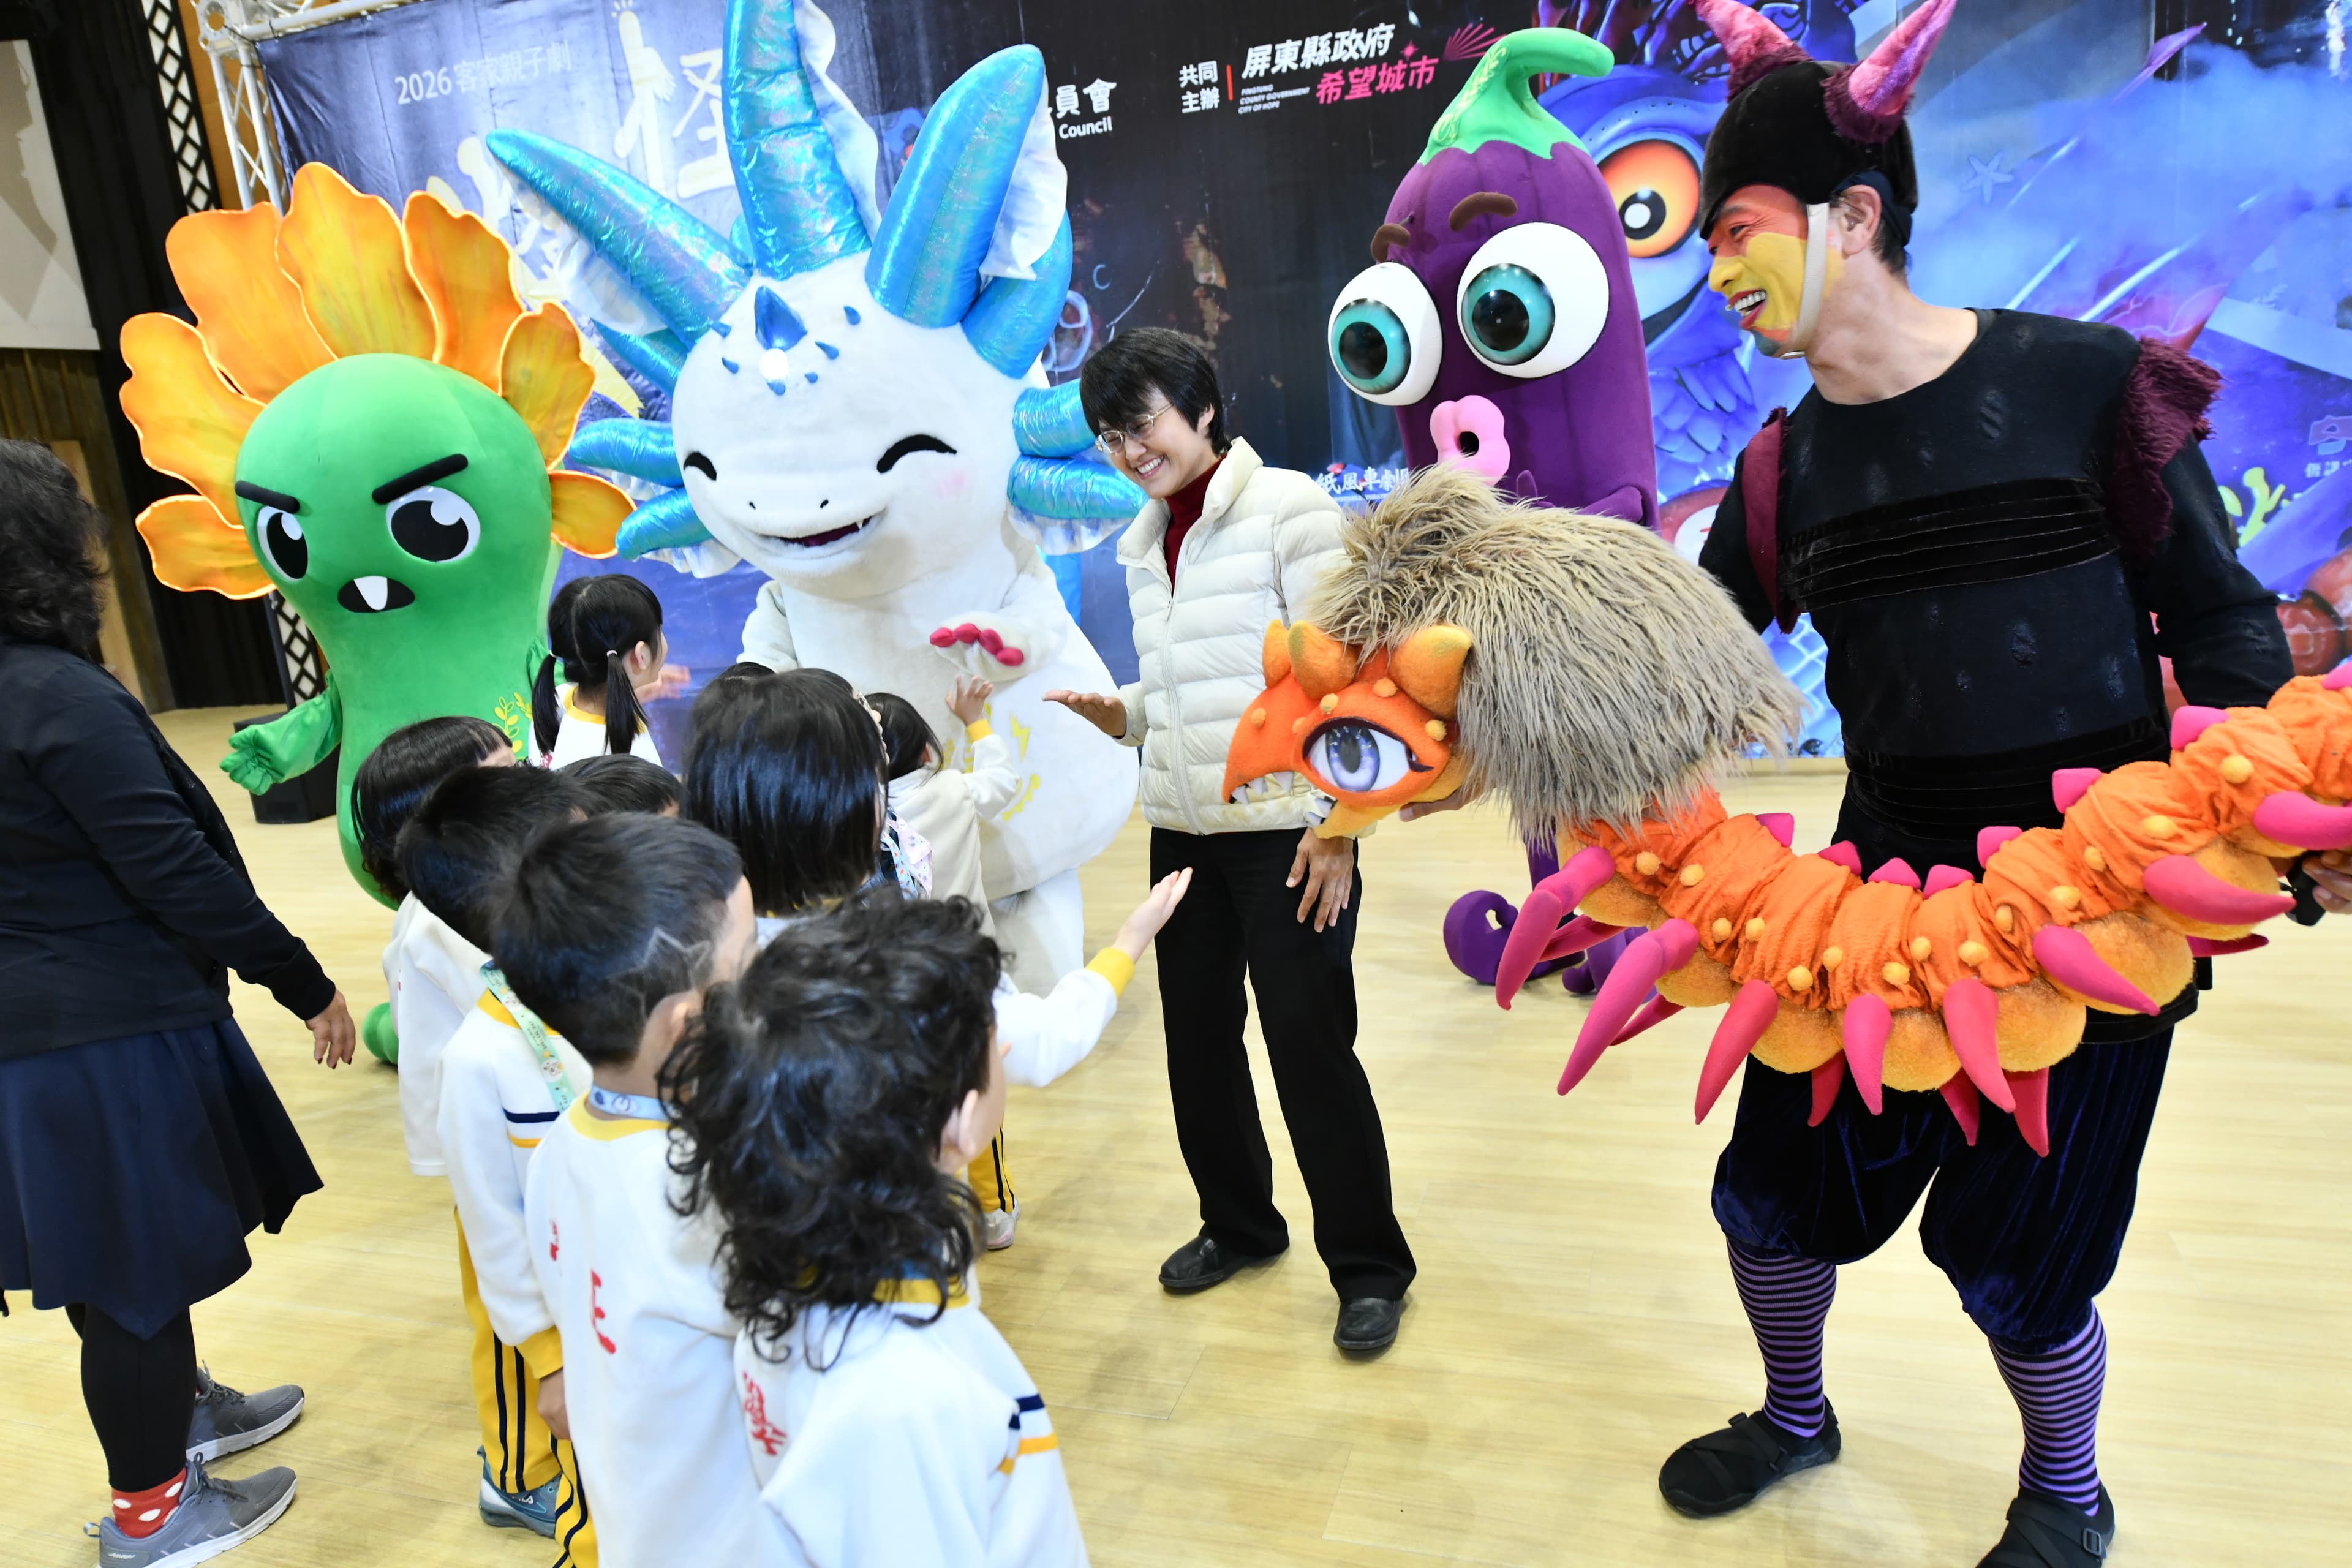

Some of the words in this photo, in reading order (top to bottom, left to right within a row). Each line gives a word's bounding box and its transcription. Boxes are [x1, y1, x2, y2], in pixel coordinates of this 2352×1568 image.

[1242, 23, 1396, 79] 屏東縣政府
[394, 67, 452, 105] 2026
[453, 39, 571, 93] 客家親子劇
[1179, 61, 1218, 88] 共同
[1316, 55, 1439, 105] 希望城市
[1048, 78, 1117, 119] 員會
[1182, 86, 1220, 114] 主辦
[1238, 105, 1252, 115] CITY
[1253, 104, 1262, 112] OF
[1240, 94, 1265, 105] COUNTY
[1266, 86, 1310, 100] GOVERNMENT
[1058, 116, 1112, 139] Council
